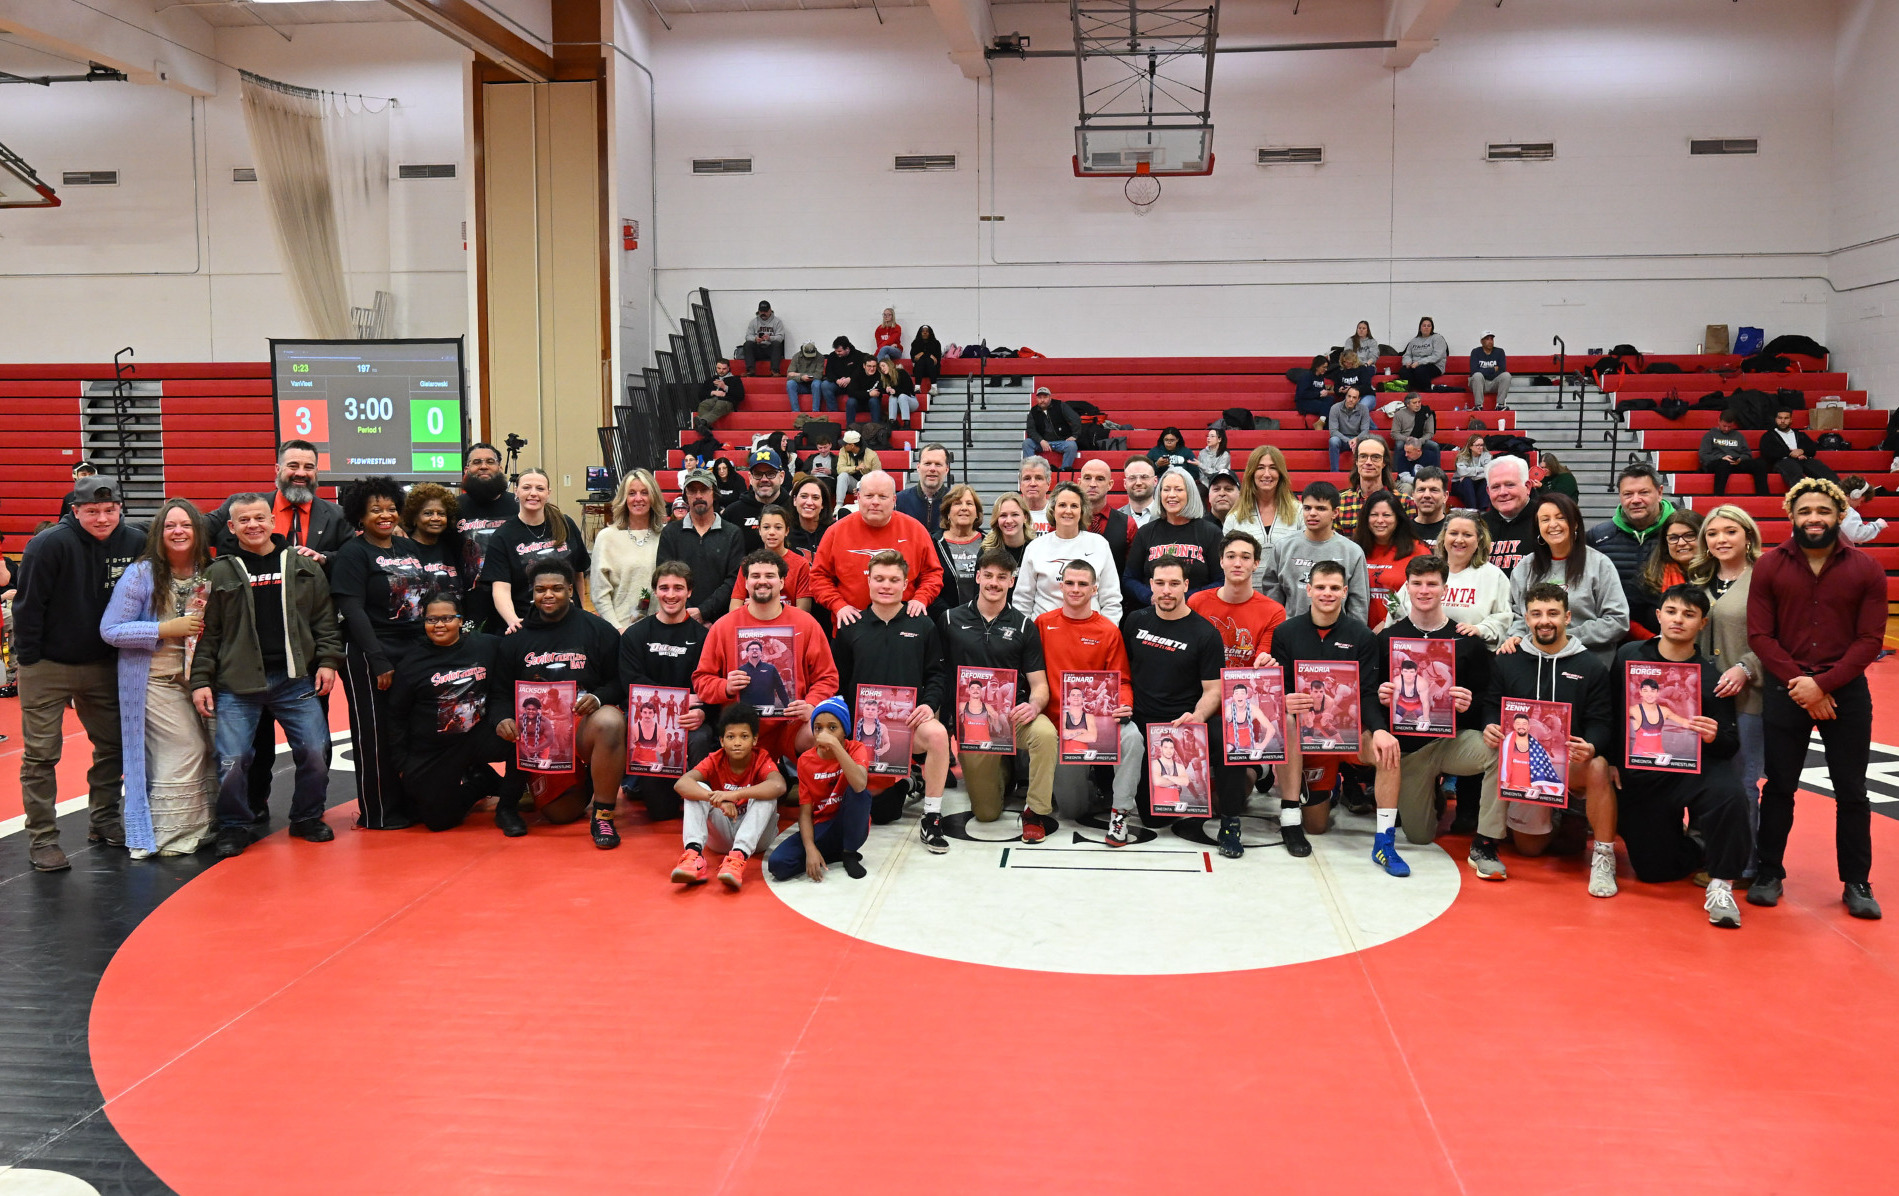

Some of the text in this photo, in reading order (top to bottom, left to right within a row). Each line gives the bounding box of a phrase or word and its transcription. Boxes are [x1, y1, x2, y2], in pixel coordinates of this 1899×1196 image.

[292, 364, 309, 373] 0:23
[357, 364, 371, 373] 197
[344, 397, 393, 421] 3:00
[295, 406, 312, 435] 3
[427, 406, 444, 435] 0
[357, 426, 382, 434] Period 1
[350, 457, 397, 465] FLOWRESTLING
[756, 451, 771, 461] M
[430, 455, 445, 468] 19
[1440, 588, 1476, 604] ONTA
[738, 631, 765, 639] MORRIS
[1136, 629, 1188, 651] ONEONTA
[524, 651, 555, 668] Senior
[570, 660, 586, 670] DAY
[961, 671, 994, 680] DEFOREST
[1630, 667, 1662, 676] BORGES
[431, 670, 460, 687] Senior
[518, 686, 548, 694] JACKSON
[1505, 704, 1530, 713] ZENNY
[1502, 790, 1523, 798] ONEONTA
[1539, 795, 1564, 803] WRESTLING
